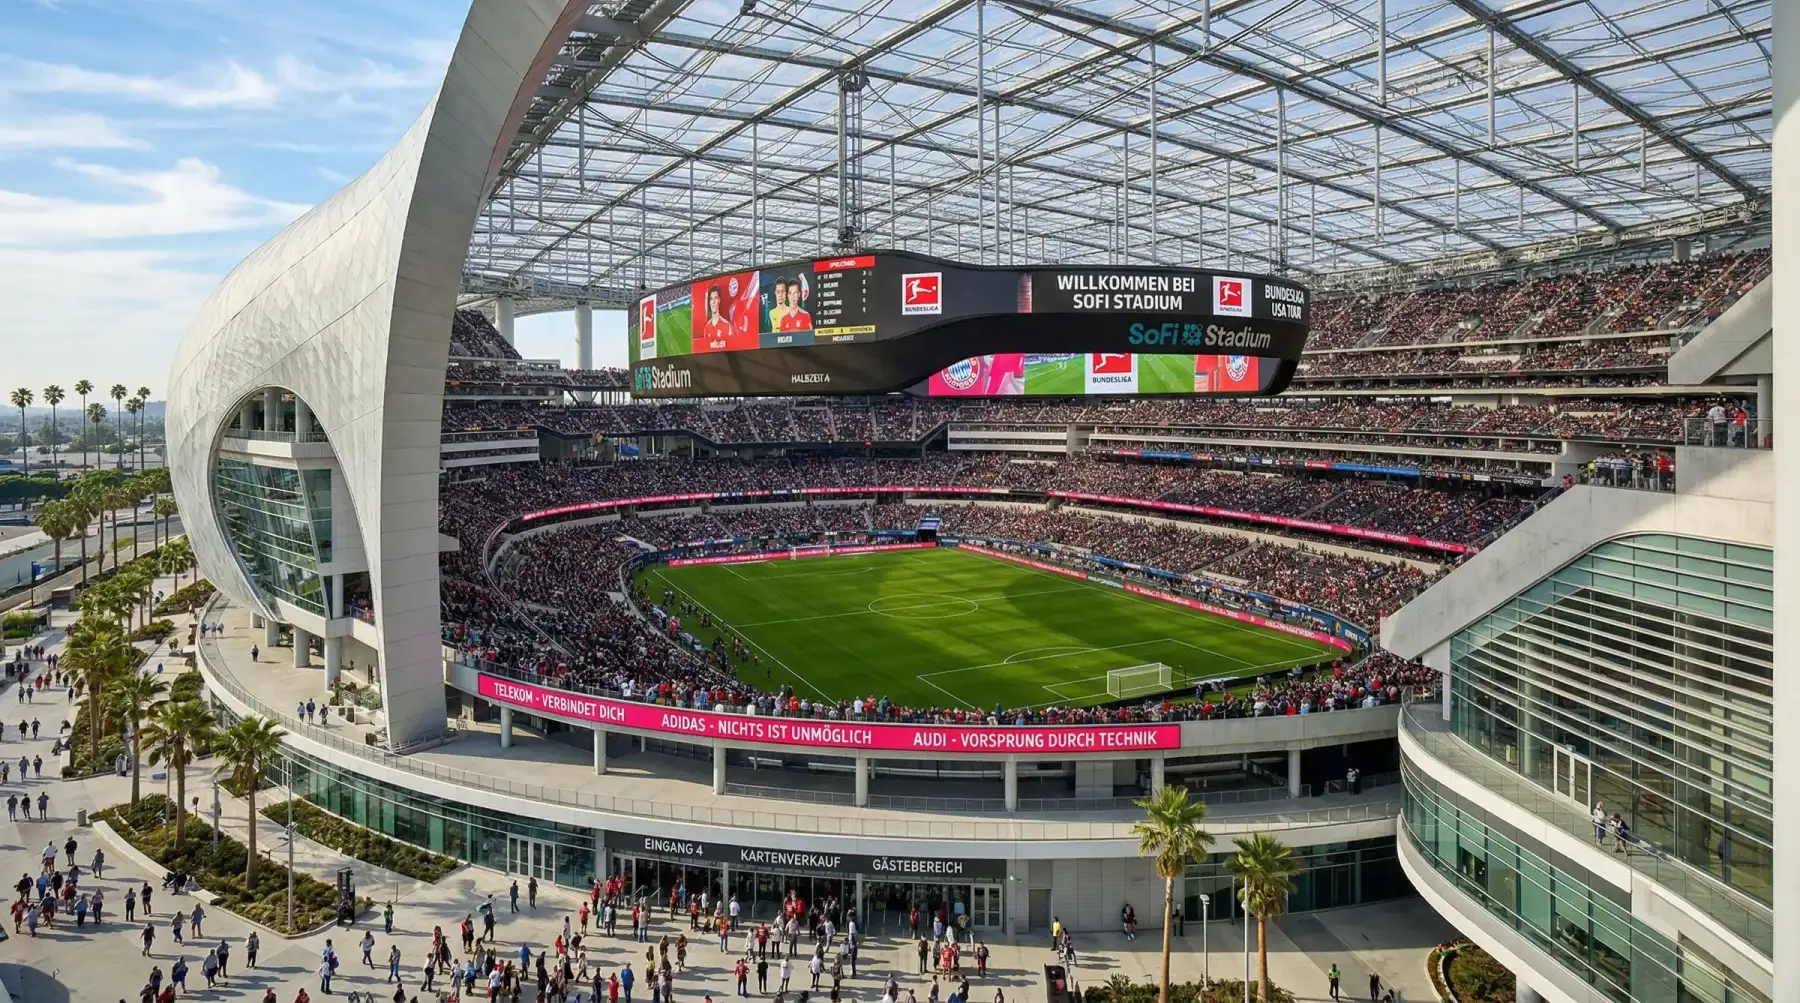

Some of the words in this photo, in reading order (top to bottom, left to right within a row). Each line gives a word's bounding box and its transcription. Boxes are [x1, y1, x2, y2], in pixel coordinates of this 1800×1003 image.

[1057, 275, 1168, 292] WILLKOMMEN
[1173, 276, 1195, 293] BEI
[1073, 293, 1109, 309] SOFI
[1113, 293, 1183, 310] STADIUM
[1265, 284, 1304, 304] BUNDESLIGA
[905, 305, 939, 313] BUNDESLIGA
[1271, 302, 1287, 318] USA
[1287, 304, 1302, 319] TOUR
[1129, 323, 1179, 345] SoFi
[1204, 324, 1271, 348] Stadium
[652, 364, 691, 389] Stadium
[1092, 376, 1132, 384] BUNDESLIGA
[493, 682, 533, 704] TELEKOM
[542, 697, 597, 717] VERBINDET
[599, 705, 625, 721] DICH
[661, 713, 706, 731] ADIDAS
[718, 720, 763, 738] NICHTS
[767, 724, 787, 739] IST
[791, 724, 872, 745] UNMÖGLICH
[913, 732, 947, 747] AUDI
[960, 732, 1044, 748] VORSPRUNG
[1048, 732, 1095, 748] DURCH
[1099, 730, 1157, 747] TECHNIK
[644, 837, 694, 855] EINGANG
[695, 845, 704, 856] 4
[740, 849, 842, 868] KARTENVERKAUF
[872, 857, 963, 874] GÄSTEBEREICH
